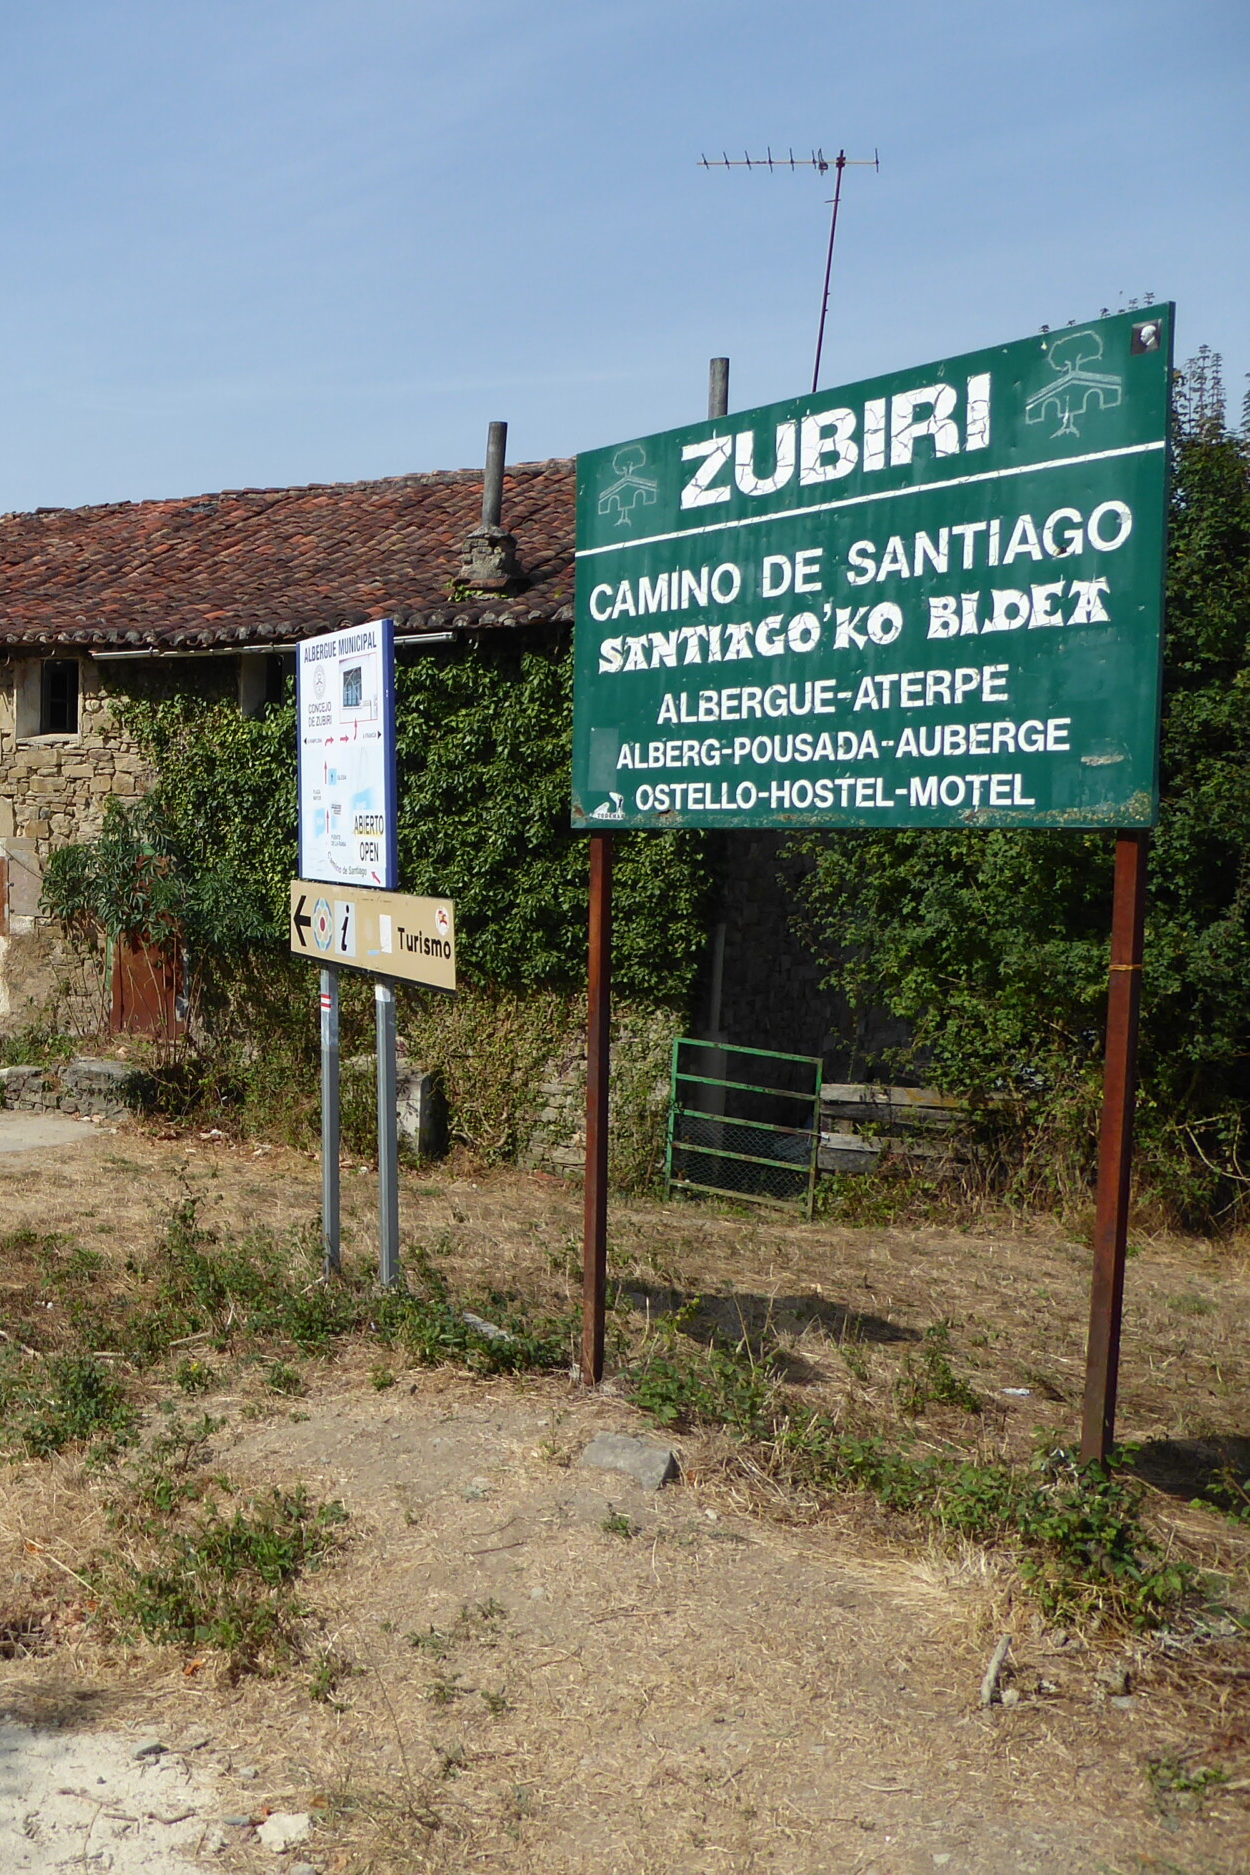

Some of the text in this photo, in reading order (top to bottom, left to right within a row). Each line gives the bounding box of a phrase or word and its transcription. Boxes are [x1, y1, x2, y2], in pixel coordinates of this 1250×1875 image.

[680, 372, 992, 510] ZUBIRI
[589, 500, 1133, 623] CAMINO DE SANTIAGO
[598, 576, 1111, 675] SANTIAGO'KO BIDEA
[304, 631, 377, 663] ALBERGUE MUNICIPAL
[308, 701, 332, 715] CONCEJO
[656, 663, 1010, 725] ALBERGUE-ATERPE
[616, 717, 1072, 770] ALBERG-POUSADA-AUBERGE
[635, 773, 1036, 811] OSTELLO-HOSTEL-MOTEL
[353, 815, 385, 837] ABIERTO
[359, 841, 379, 862] OPEN
[397, 926, 452, 960] Turismo
